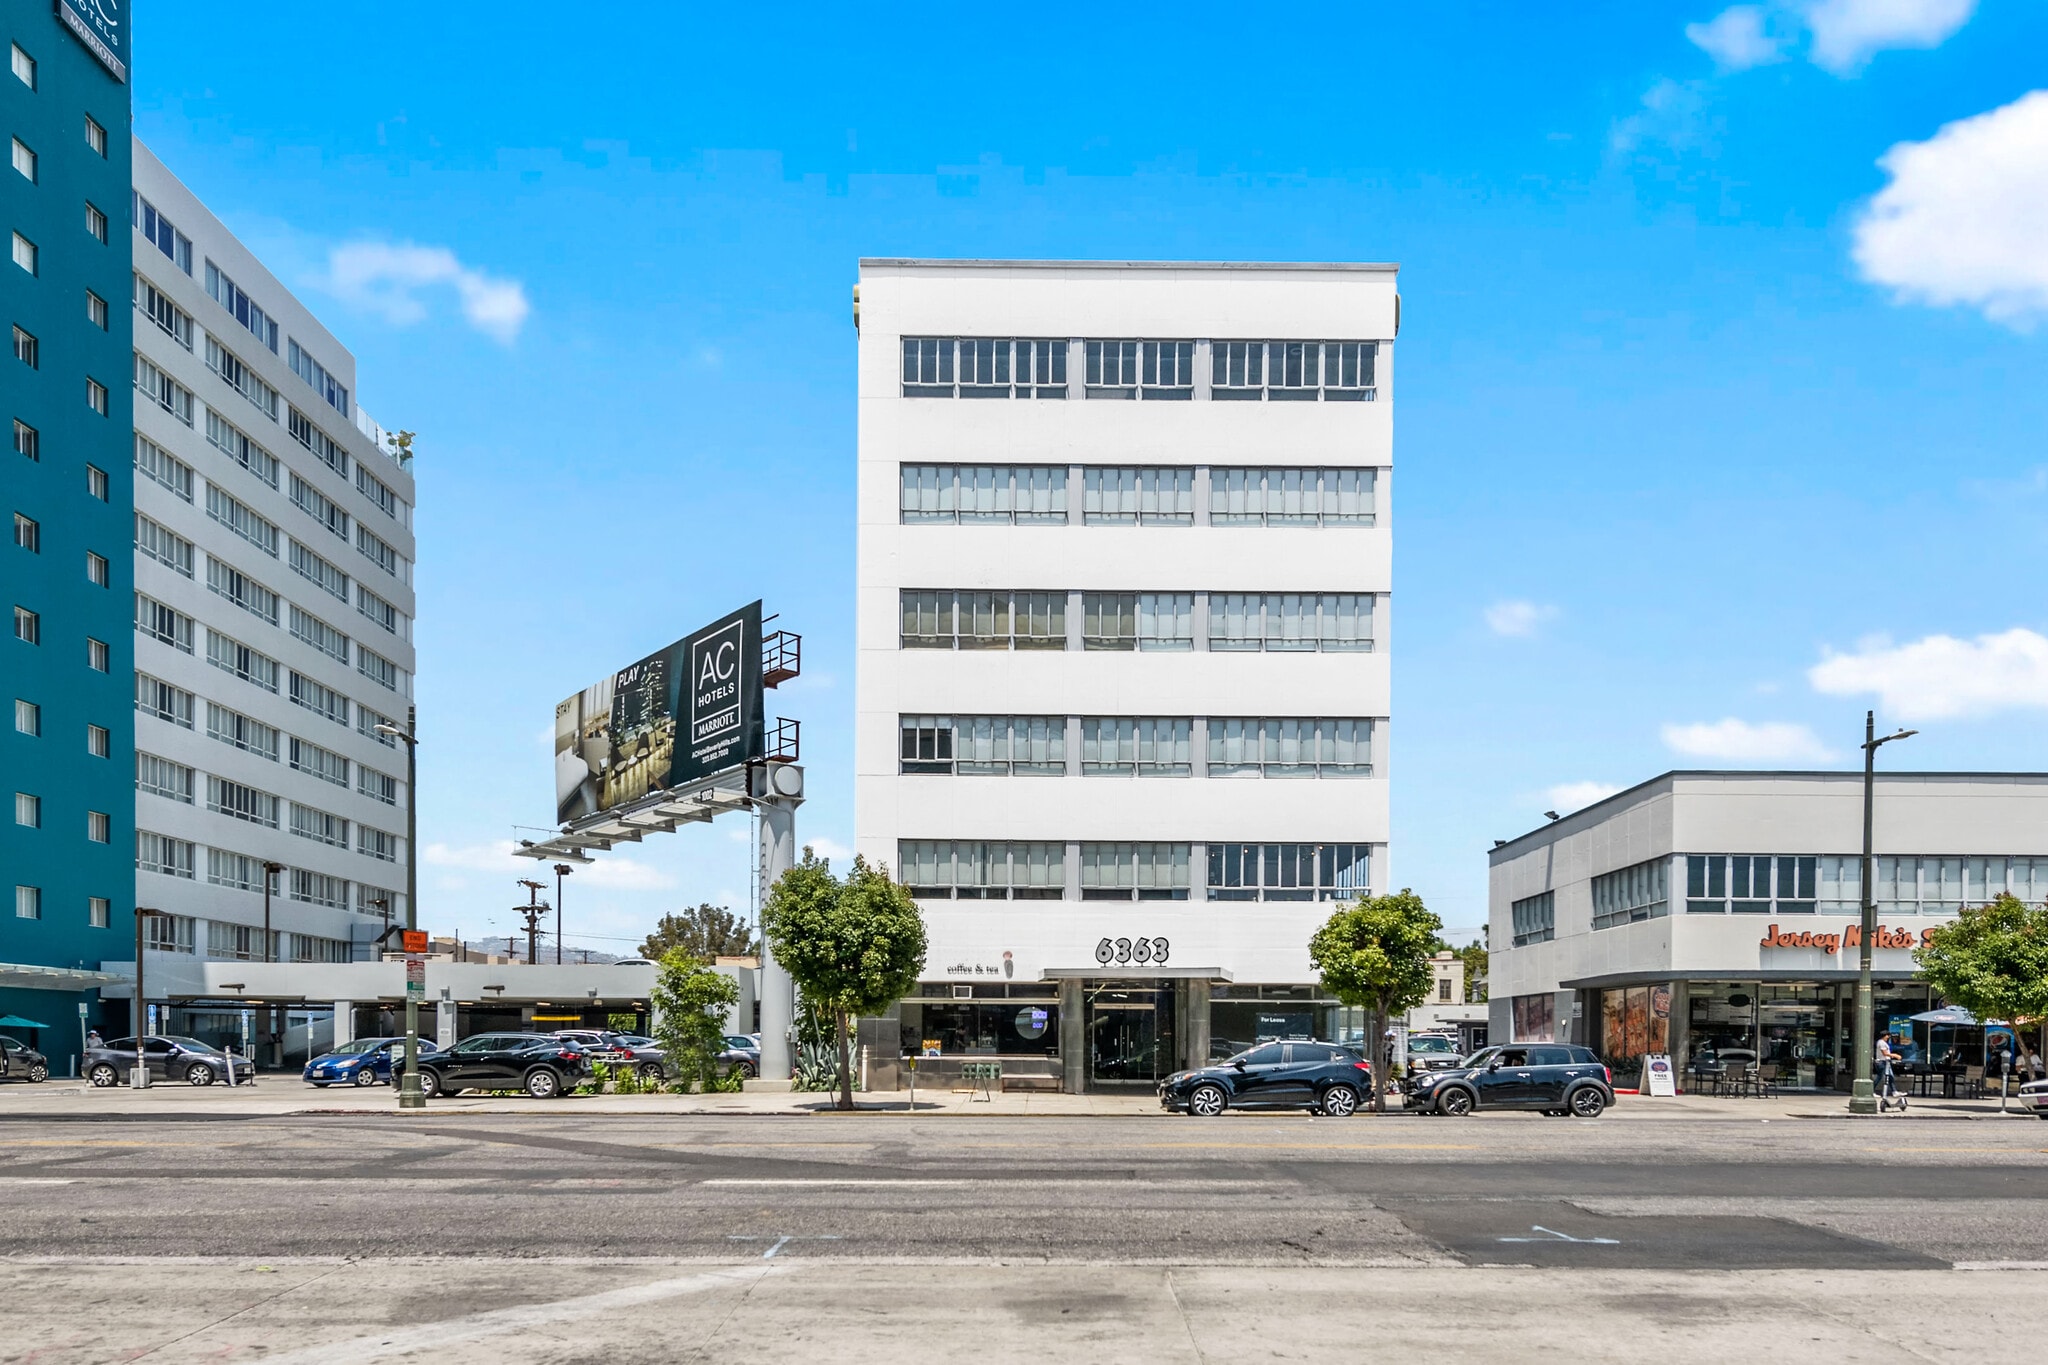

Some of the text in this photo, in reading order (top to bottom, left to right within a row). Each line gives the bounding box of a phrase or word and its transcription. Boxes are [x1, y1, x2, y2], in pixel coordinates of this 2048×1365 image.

[74, 0, 118, 46] OTELS
[70, 15, 119, 70] MARRIOTT
[618, 665, 640, 689] PLAY
[699, 641, 735, 690] AC
[698, 683, 735, 708] HOTELS
[556, 701, 572, 719] STAY
[698, 712, 735, 736] MARRIOTT
[701, 789, 713, 802] 1002
[1095, 937, 1169, 964] 6363
[1761, 924, 1840, 955] Jersey
[947, 963, 1000, 975] coffee & tea
